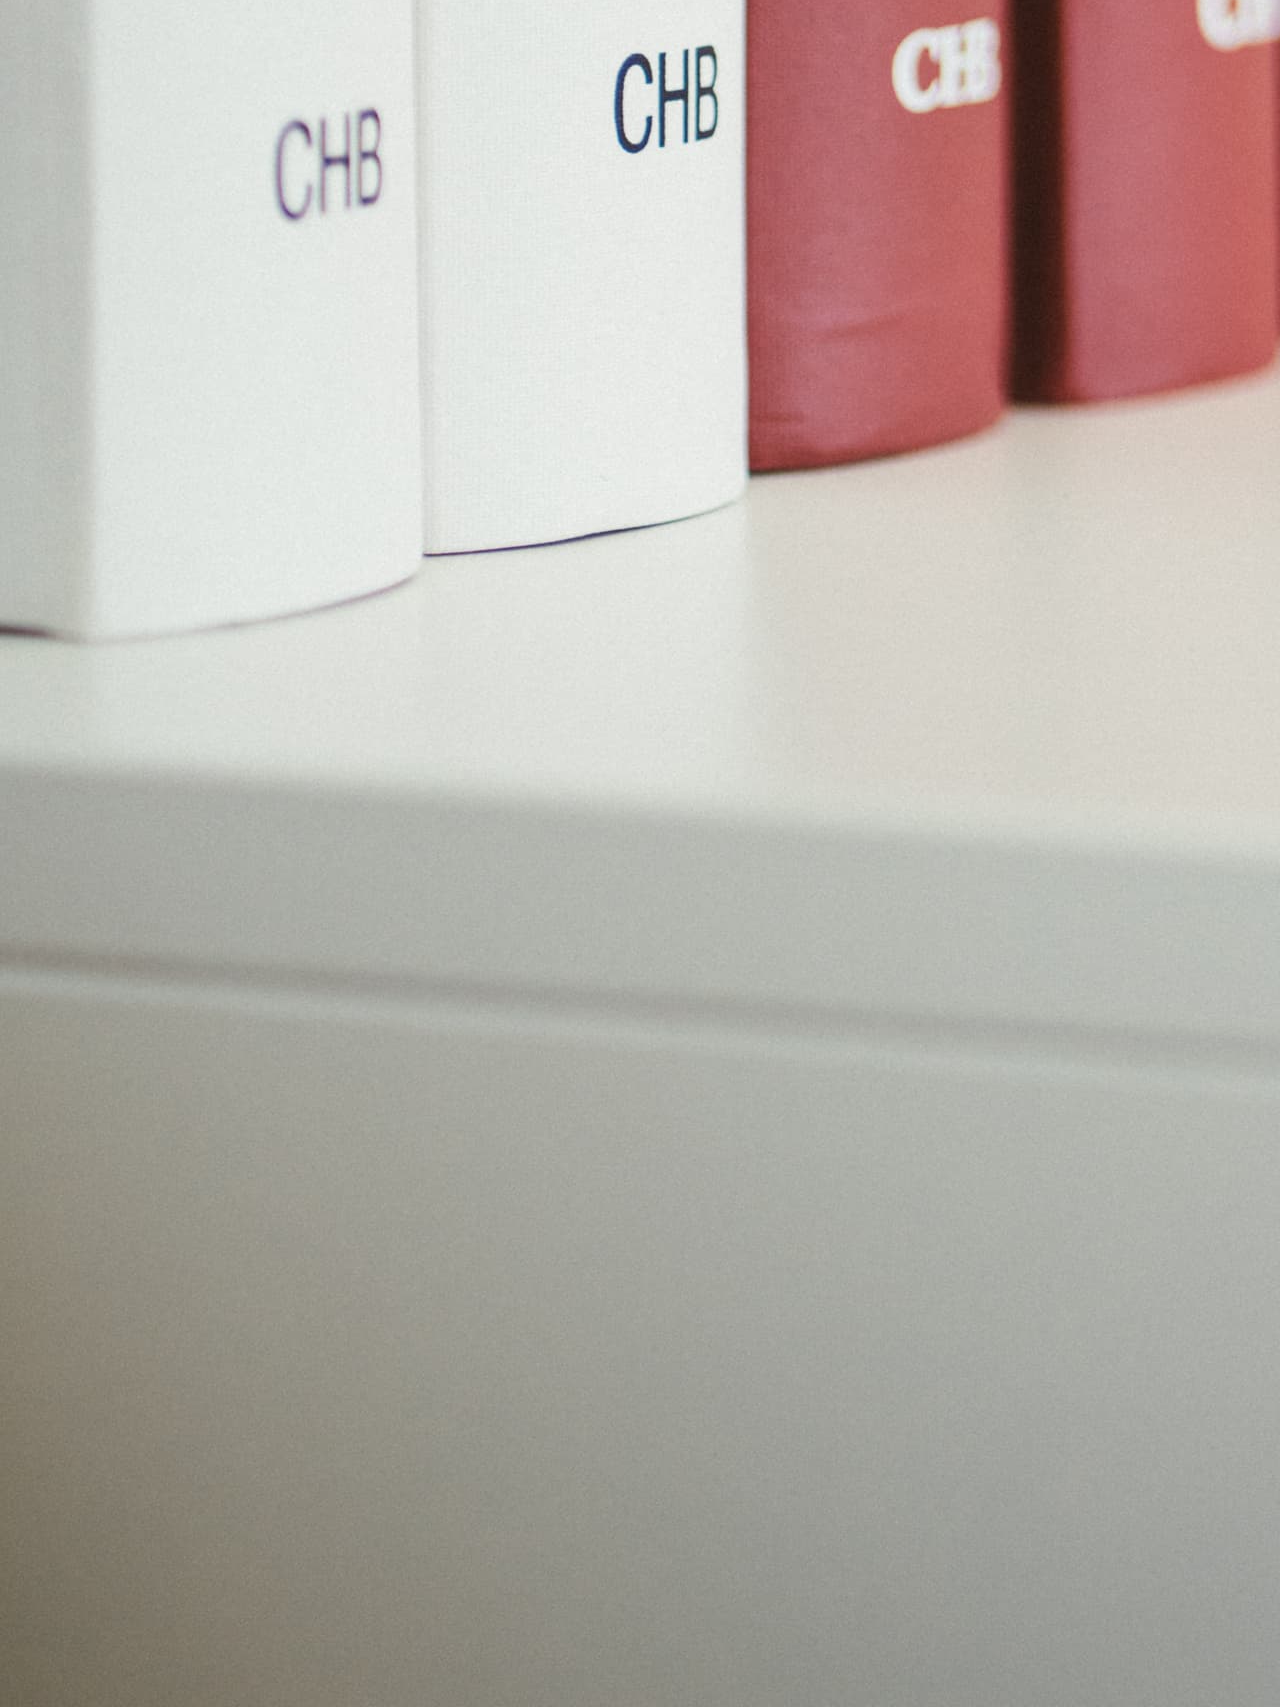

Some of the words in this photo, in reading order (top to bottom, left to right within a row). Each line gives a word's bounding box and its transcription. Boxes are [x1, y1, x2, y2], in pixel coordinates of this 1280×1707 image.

[613, 44, 719, 155] CHB
[891, 17, 1001, 114] CHB
[272, 106, 384, 223] CHB
